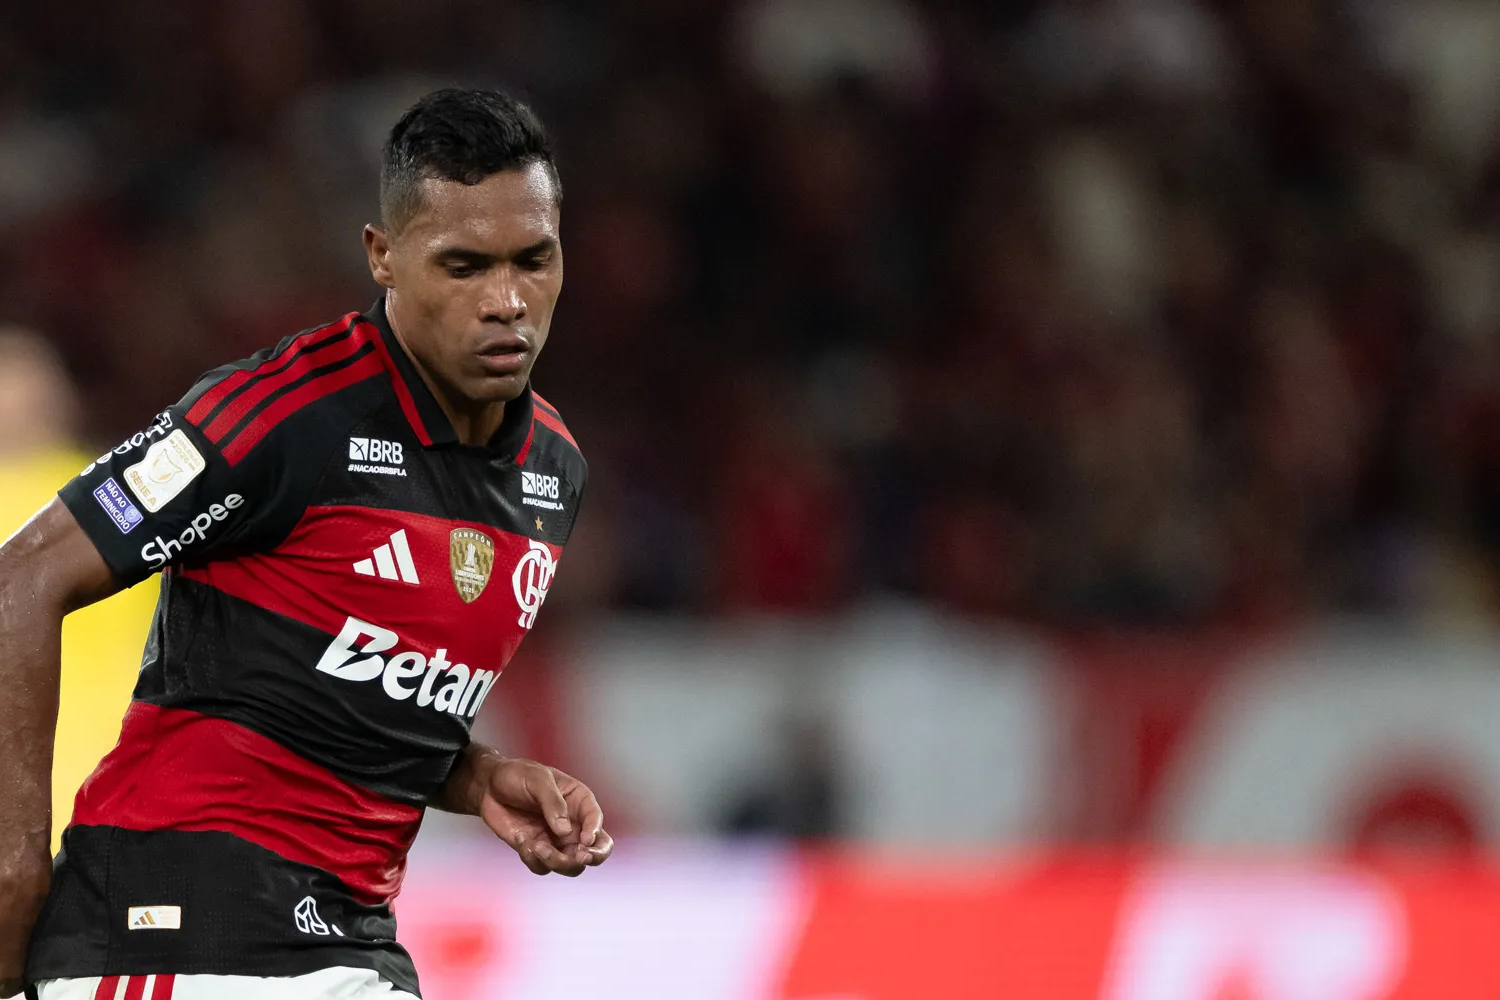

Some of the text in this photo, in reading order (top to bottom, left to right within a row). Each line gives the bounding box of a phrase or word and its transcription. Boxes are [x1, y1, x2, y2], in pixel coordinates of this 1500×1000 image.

[369, 438, 404, 465] BRB
[347, 463, 407, 477] #NACAOBRBFLA
[105, 481, 127, 508] NÃO AO
[536, 473, 560, 499] BRB
[96, 489, 130, 530] FEMINICÍDIO
[141, 492, 245, 570] Shopee
[453, 532, 491, 548] CAMPEÓN
[315, 616, 502, 717] Betan
